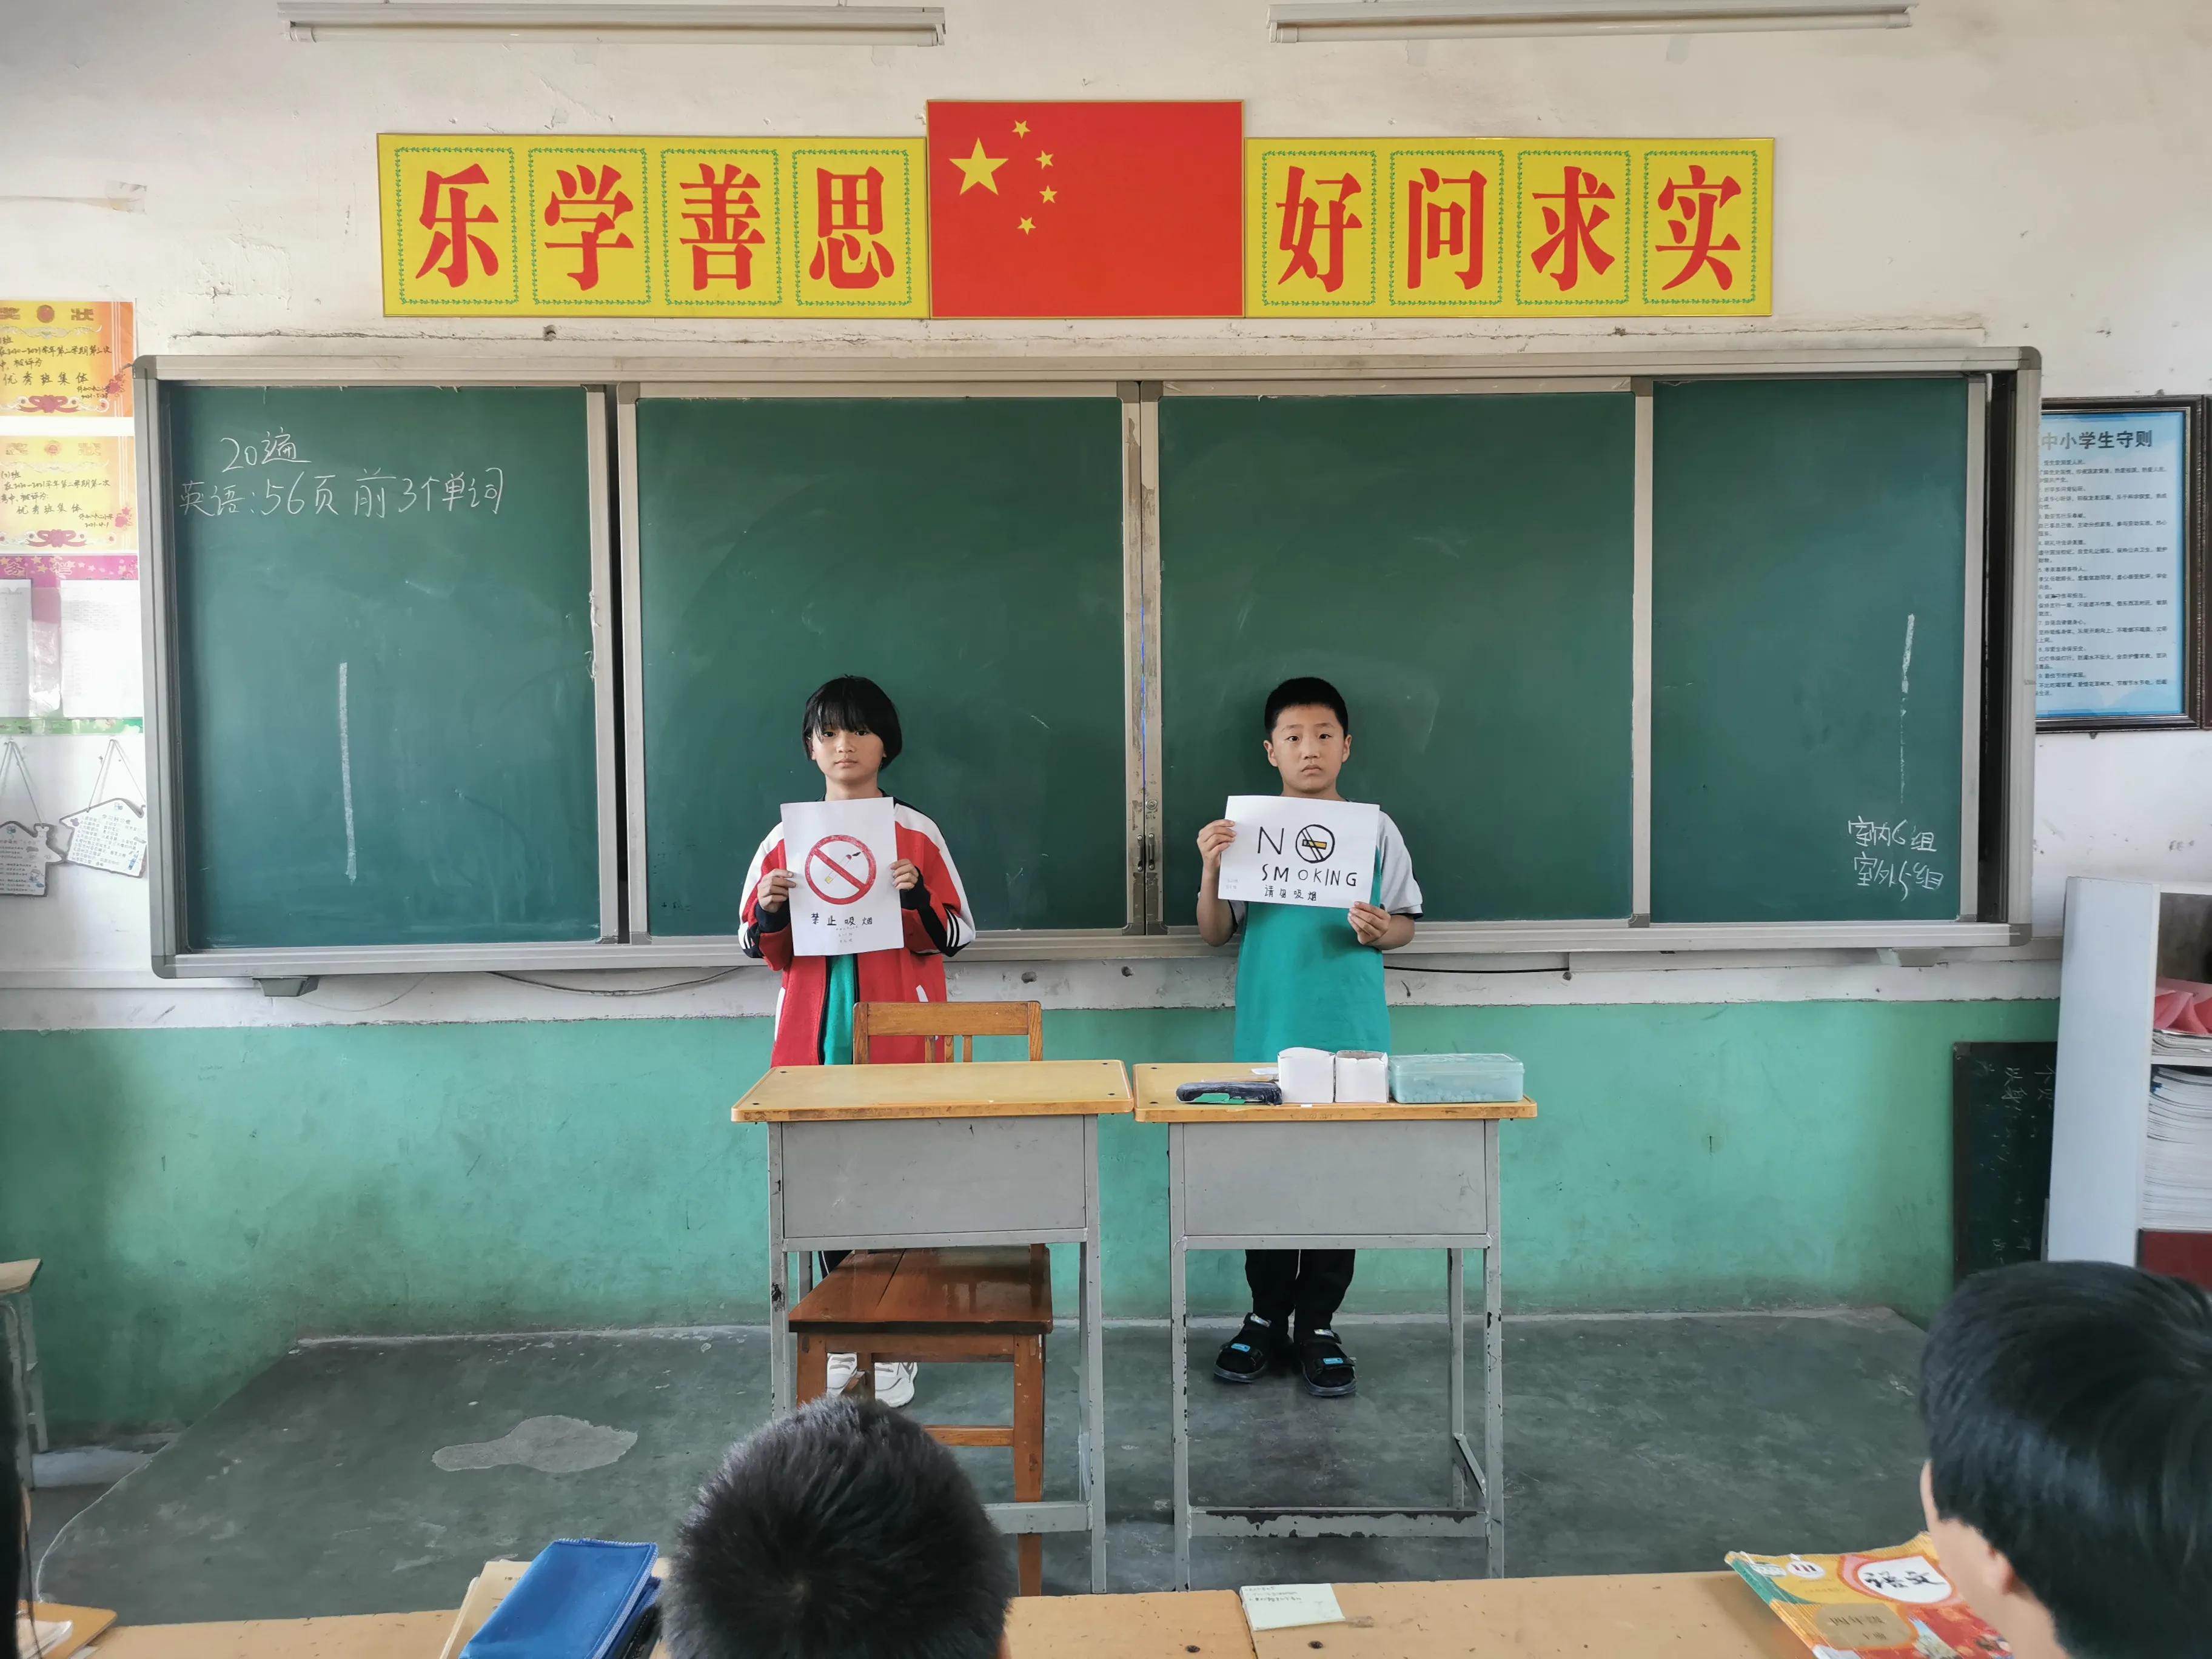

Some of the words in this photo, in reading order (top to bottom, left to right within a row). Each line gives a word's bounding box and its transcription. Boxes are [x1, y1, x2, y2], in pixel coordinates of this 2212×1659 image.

[416, 163, 894, 290] 乐学善思
[1276, 164, 1742, 293] 好问求实
[221, 427, 312, 472] 20遍
[2042, 430, 2152, 451] 中小学生守则
[1848, 815, 1937, 852] 室内6组
[1261, 863, 1358, 887] SMOKING
[811, 912, 873, 926] 禁止吸烟
[1863, 1570, 1946, 1589] 语文
